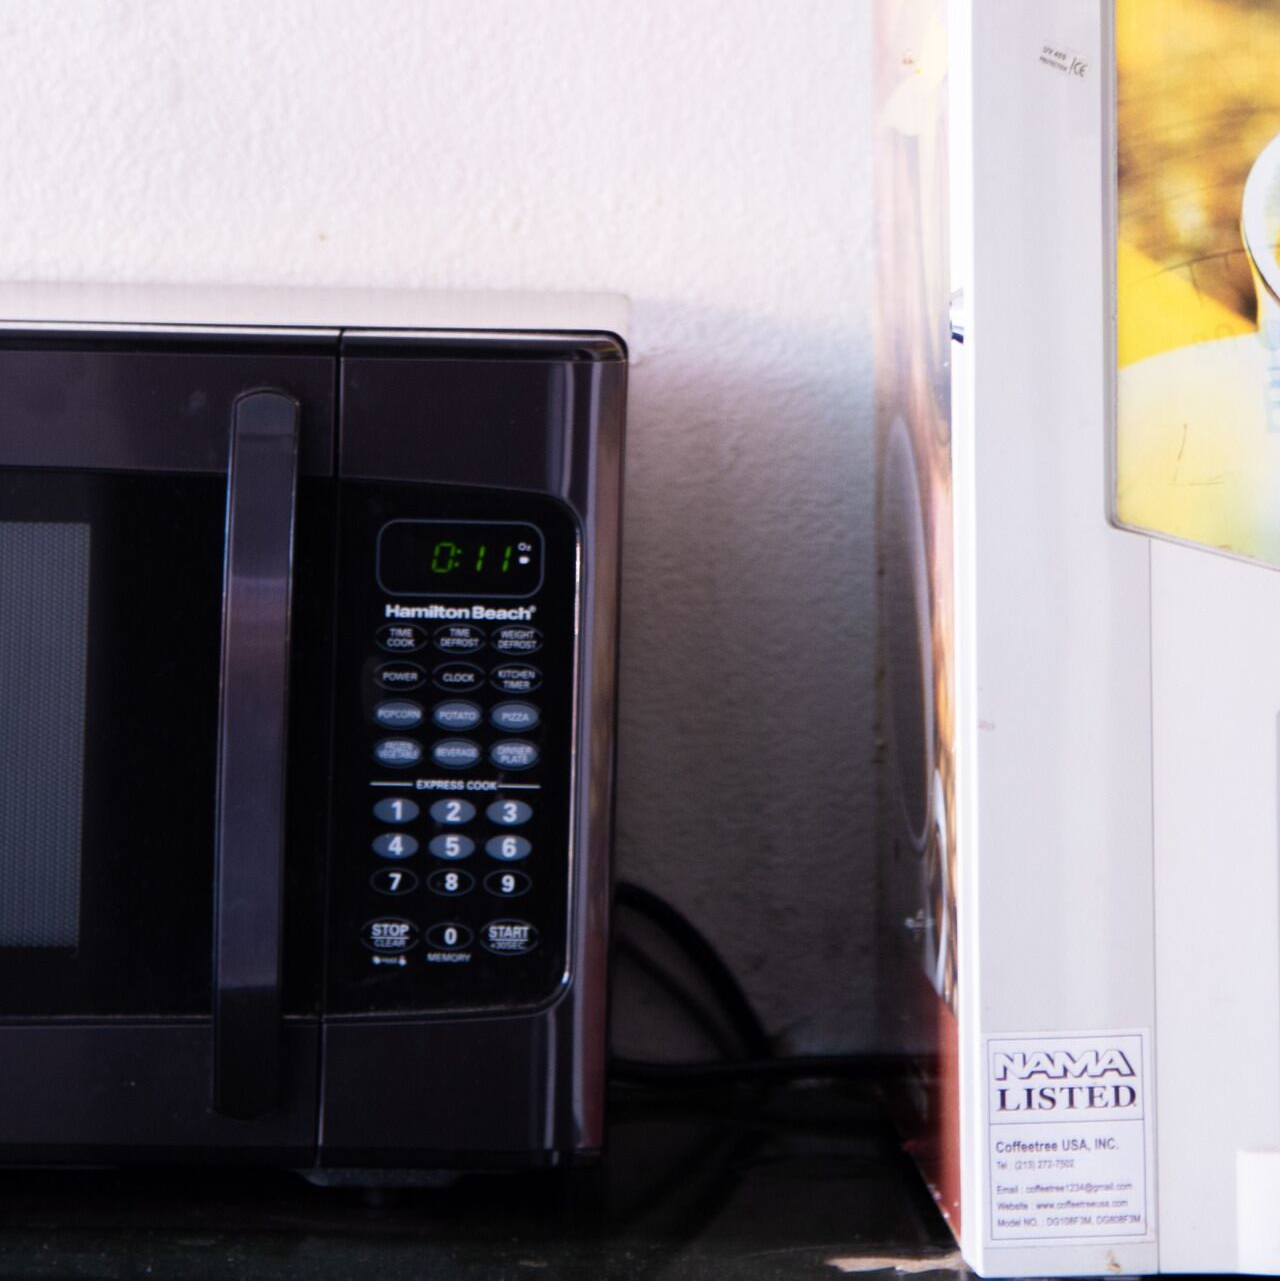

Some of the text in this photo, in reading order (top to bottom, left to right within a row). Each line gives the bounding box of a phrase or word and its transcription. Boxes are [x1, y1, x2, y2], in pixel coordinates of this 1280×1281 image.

[430, 541, 512, 573] 0:11
[384, 604, 470, 619] Hamilton
[389, 627, 413, 638] TIME
[449, 627, 470, 638] TIME
[500, 629, 535, 640] WEIGHT
[386, 638, 415, 648] COOK
[440, 637, 479, 648] DEFROST
[497, 639, 537, 650] DEFROST
[382, 671, 418, 682] POWER
[442, 672, 475, 683] CLOCK
[497, 669, 536, 680] KITCHEN
[503, 679, 531, 690] TIMER
[376, 708, 422, 719] POPCORN
[439, 710, 477, 721] POTATO
[501, 711, 530, 722] PIZZA
[500, 754, 529, 764] PLATE
[415, 779, 498, 791] EXPRESS COOK
[391, 801, 403, 821] 1
[445, 801, 461, 822] 2
[503, 802, 518, 823] 3
[387, 835, 403, 856] 4
[445, 835, 460, 857] 5
[501, 837, 516, 858] 6
[388, 872, 402, 891] 7
[444, 872, 459, 891] 8
[501, 874, 515, 893] 9
[371, 923, 410, 937] STOP
[444, 927, 458, 945] 0
[488, 925, 530, 939] START
[374, 938, 406, 948] CLEAR
[427, 953, 472, 963] MEMORY
[992, 1049, 1137, 1081] NAMA
[995, 1138, 1119, 1154] Coffeetree USA, INC.
